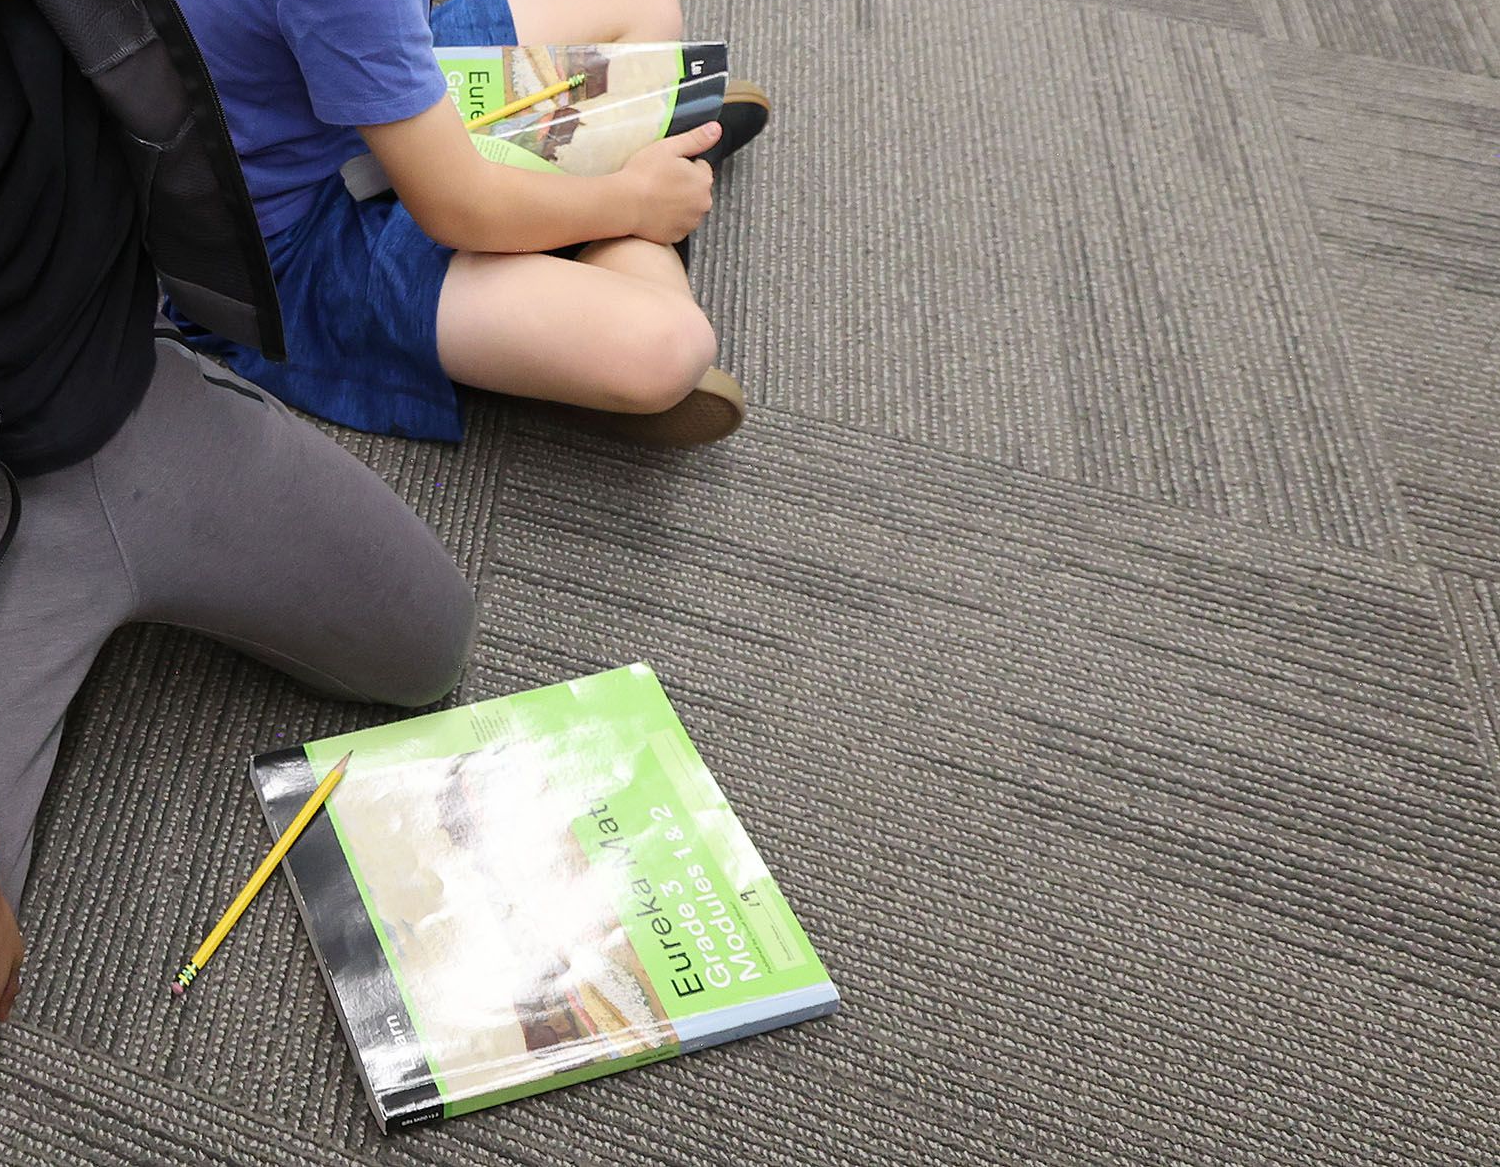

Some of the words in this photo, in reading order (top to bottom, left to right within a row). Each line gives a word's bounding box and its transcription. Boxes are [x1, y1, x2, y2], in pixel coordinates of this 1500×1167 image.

[468, 70, 490, 120] Eure
[583, 796, 638, 870] Mat
[649, 803, 673, 821] 2
[664, 826, 684, 842] &
[671, 847, 693, 860] 1
[659, 879, 685, 898] 3
[631, 878, 706, 998] Eureka
[677, 902, 732, 989] Grade
[687, 864, 763, 983] Modules
[383, 1013, 416, 1072] Larn
